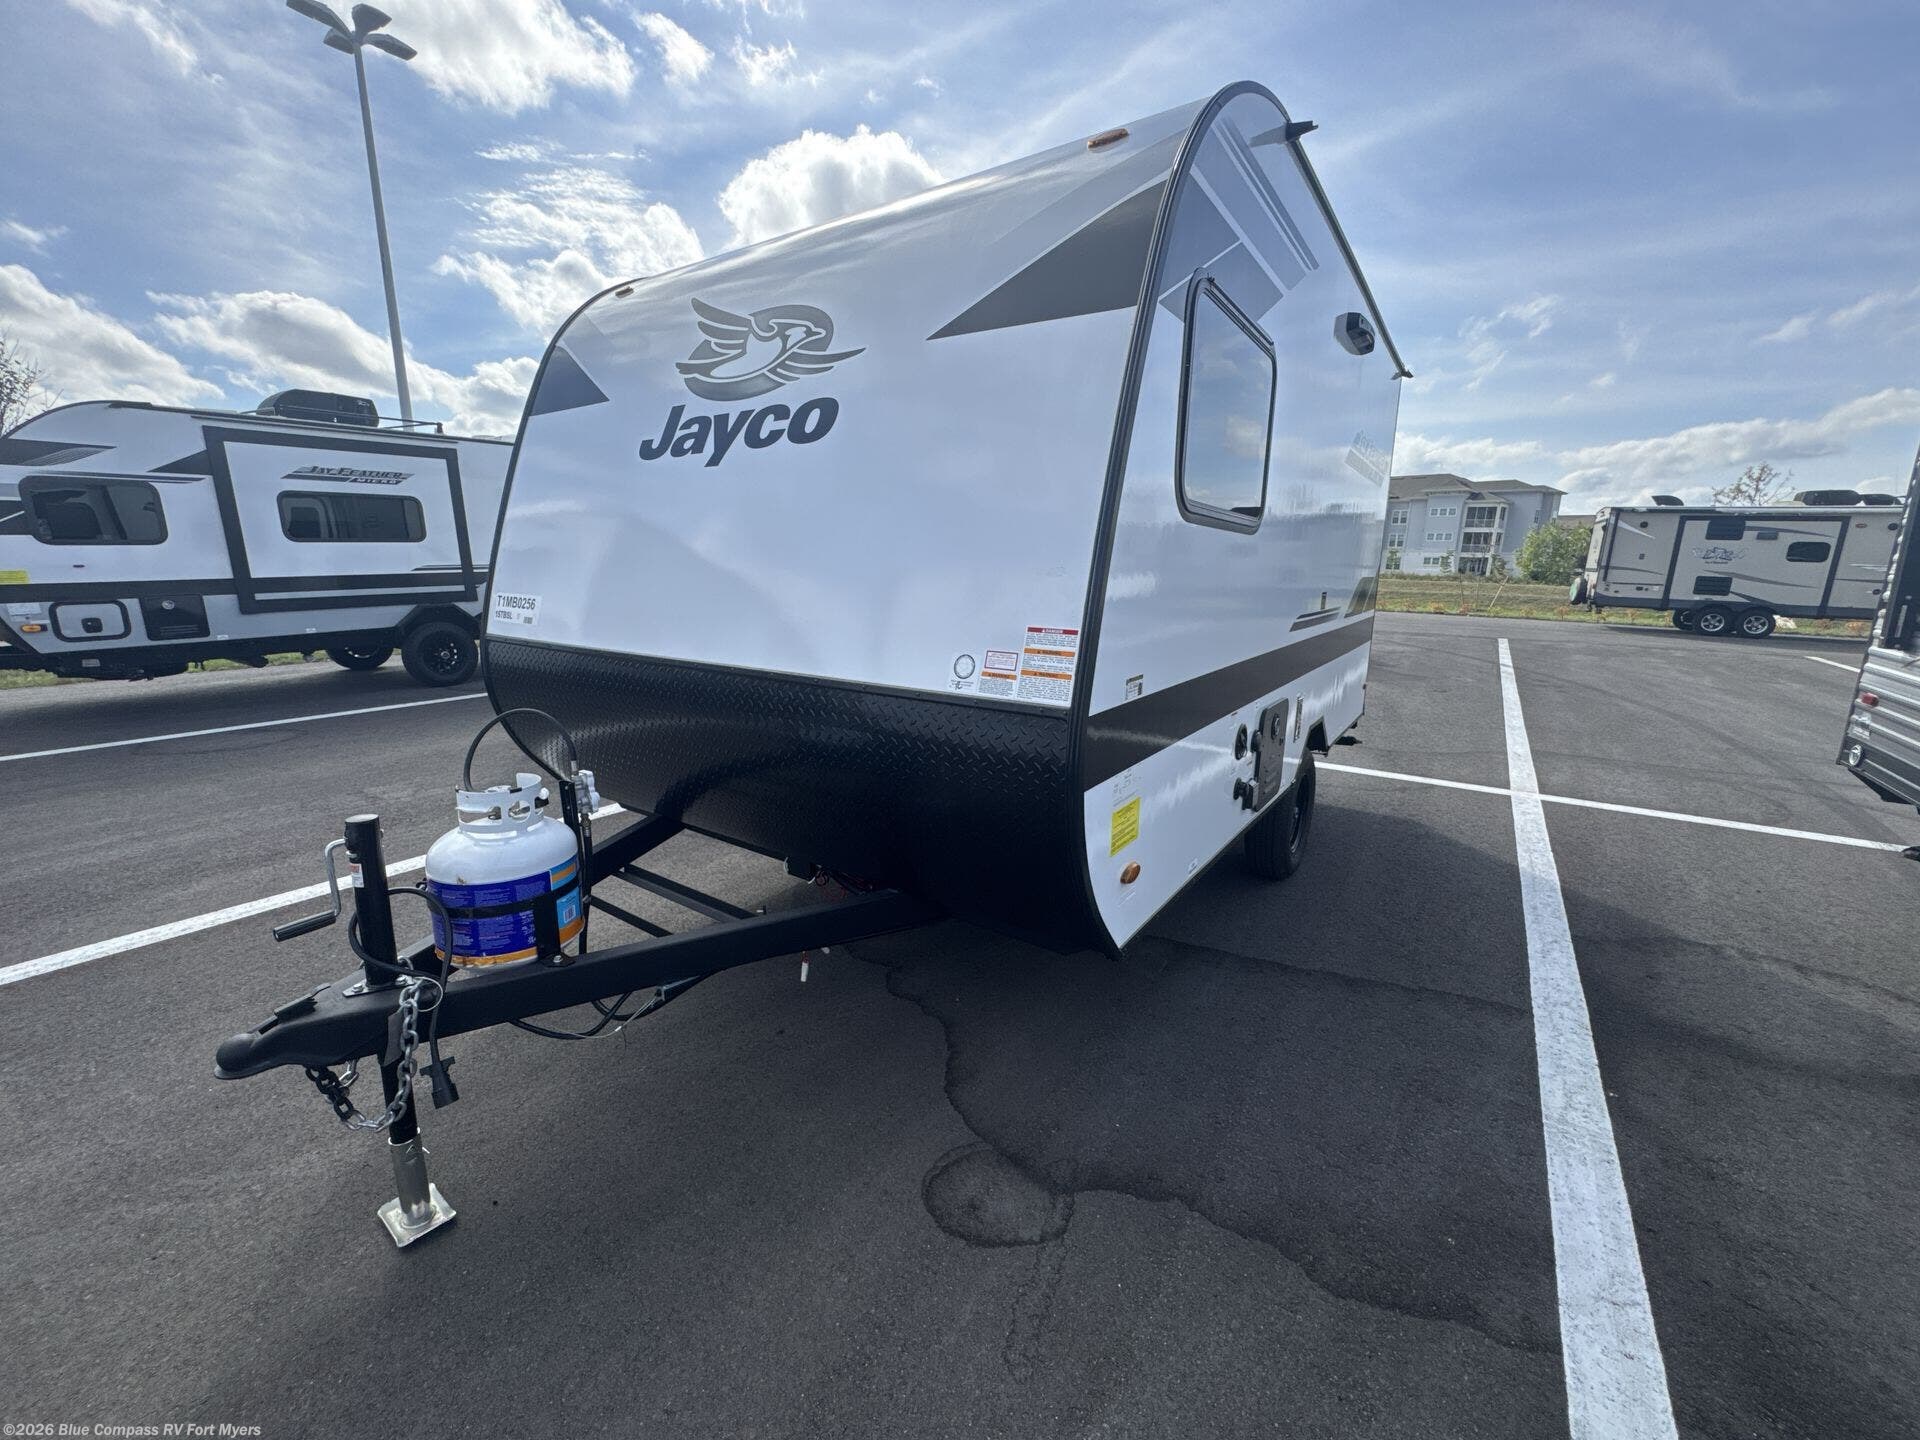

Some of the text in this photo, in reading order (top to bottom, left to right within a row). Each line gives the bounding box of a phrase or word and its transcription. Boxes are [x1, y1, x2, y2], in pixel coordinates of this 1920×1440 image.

[638, 396, 840, 468] Jayco
[338, 467, 403, 478] FEATHER
[496, 596, 536, 609] T1MB0256
